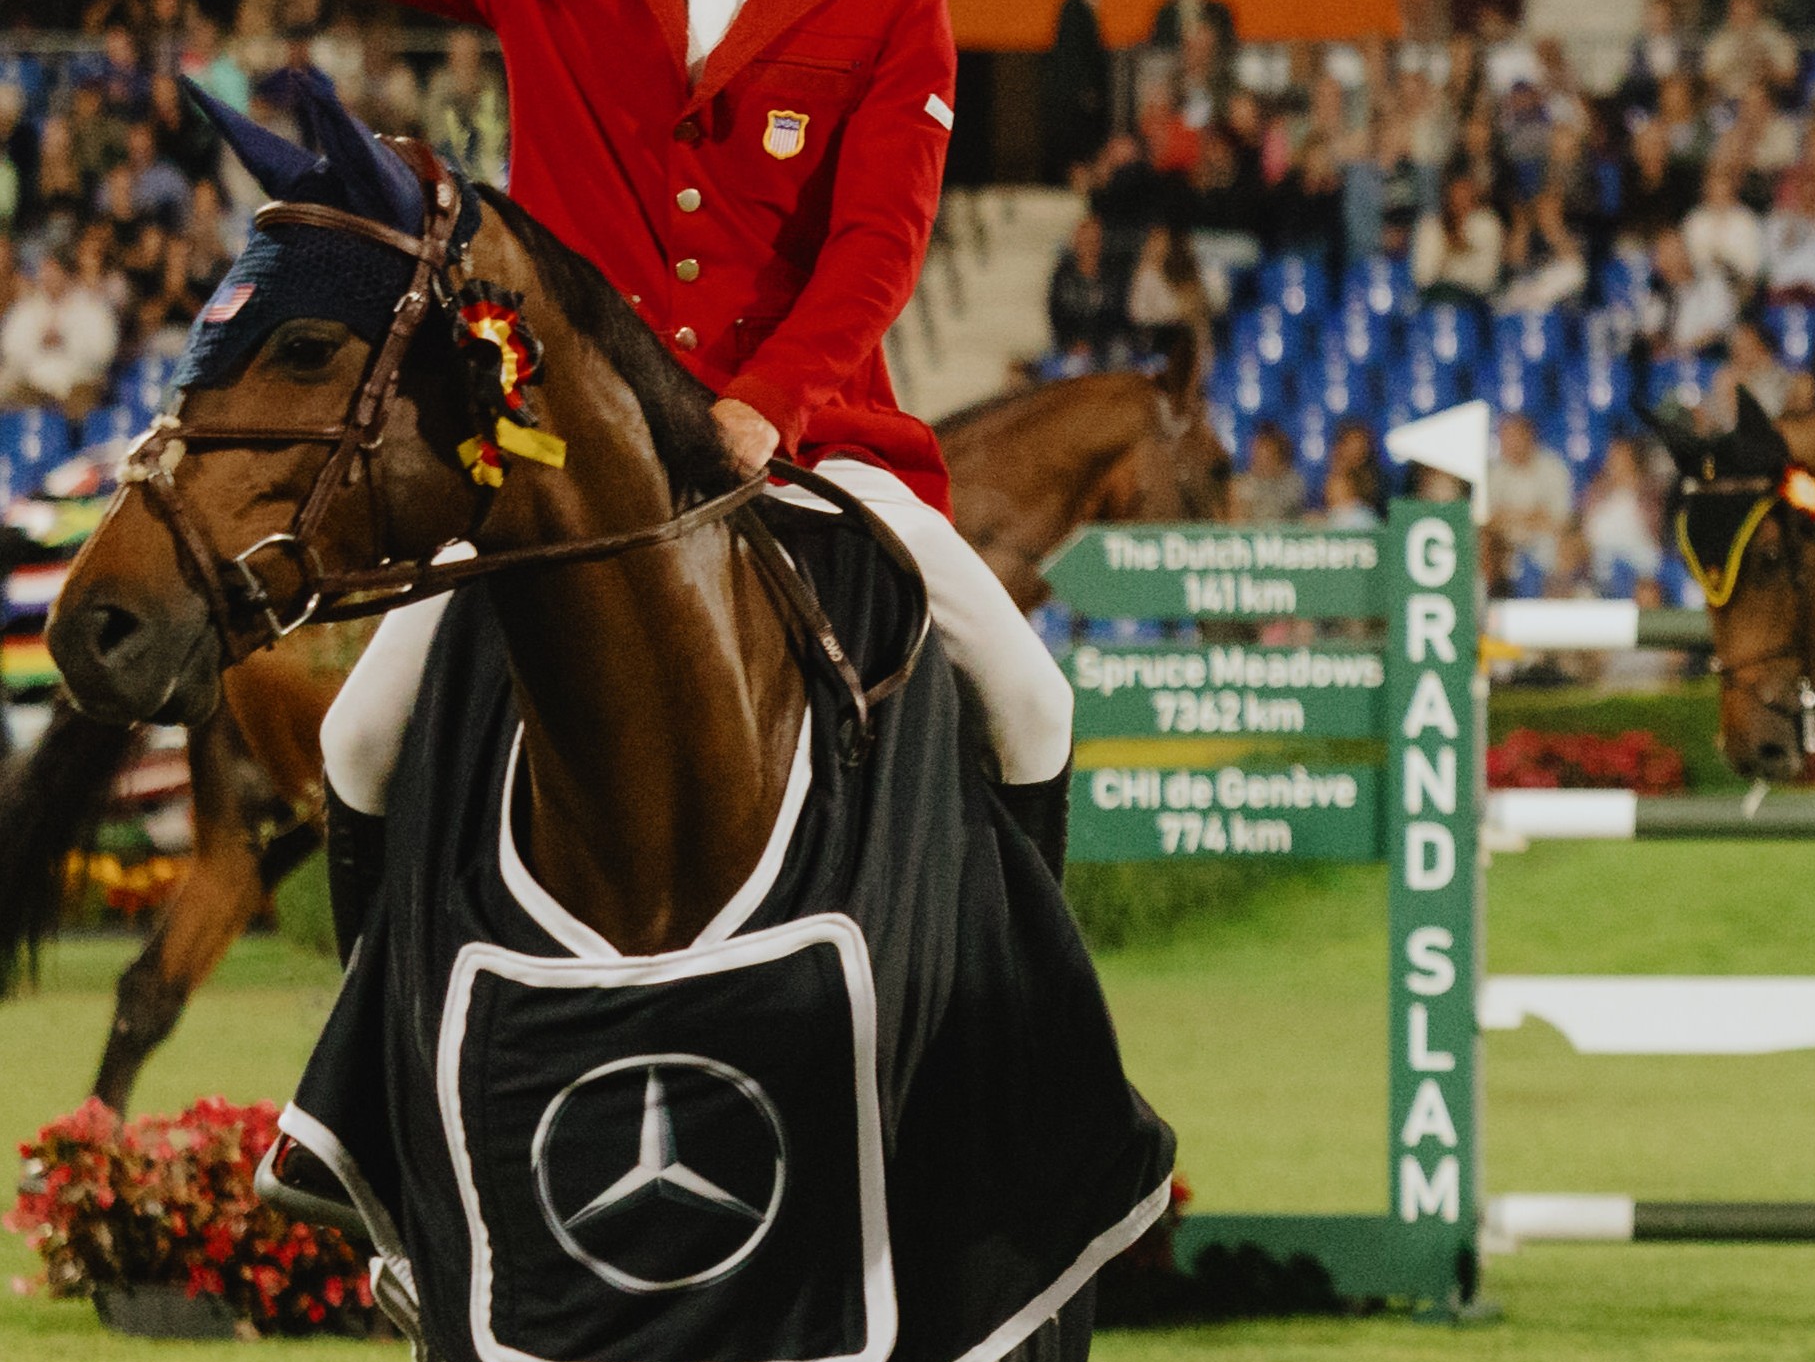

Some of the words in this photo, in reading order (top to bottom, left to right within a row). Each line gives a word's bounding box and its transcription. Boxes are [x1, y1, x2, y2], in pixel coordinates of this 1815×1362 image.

[1104, 531, 1160, 570] The
[1163, 531, 1249, 570] Dutch
[1254, 533, 1377, 570] Masters
[1185, 573, 1236, 613] 141
[1239, 573, 1296, 613] km
[1075, 645, 1207, 696] Spruce
[1209, 645, 1385, 688] Meadows
[1154, 692, 1242, 732] 7362
[1243, 692, 1305, 732] km
[1403, 517, 1459, 891] GRAND
[1092, 768, 1162, 809] CHI
[1164, 771, 1213, 809] de
[1215, 764, 1358, 809] Genève
[1156, 812, 1227, 854] 774
[1229, 812, 1292, 853] km
[1400, 925, 1460, 1224] SLAM
